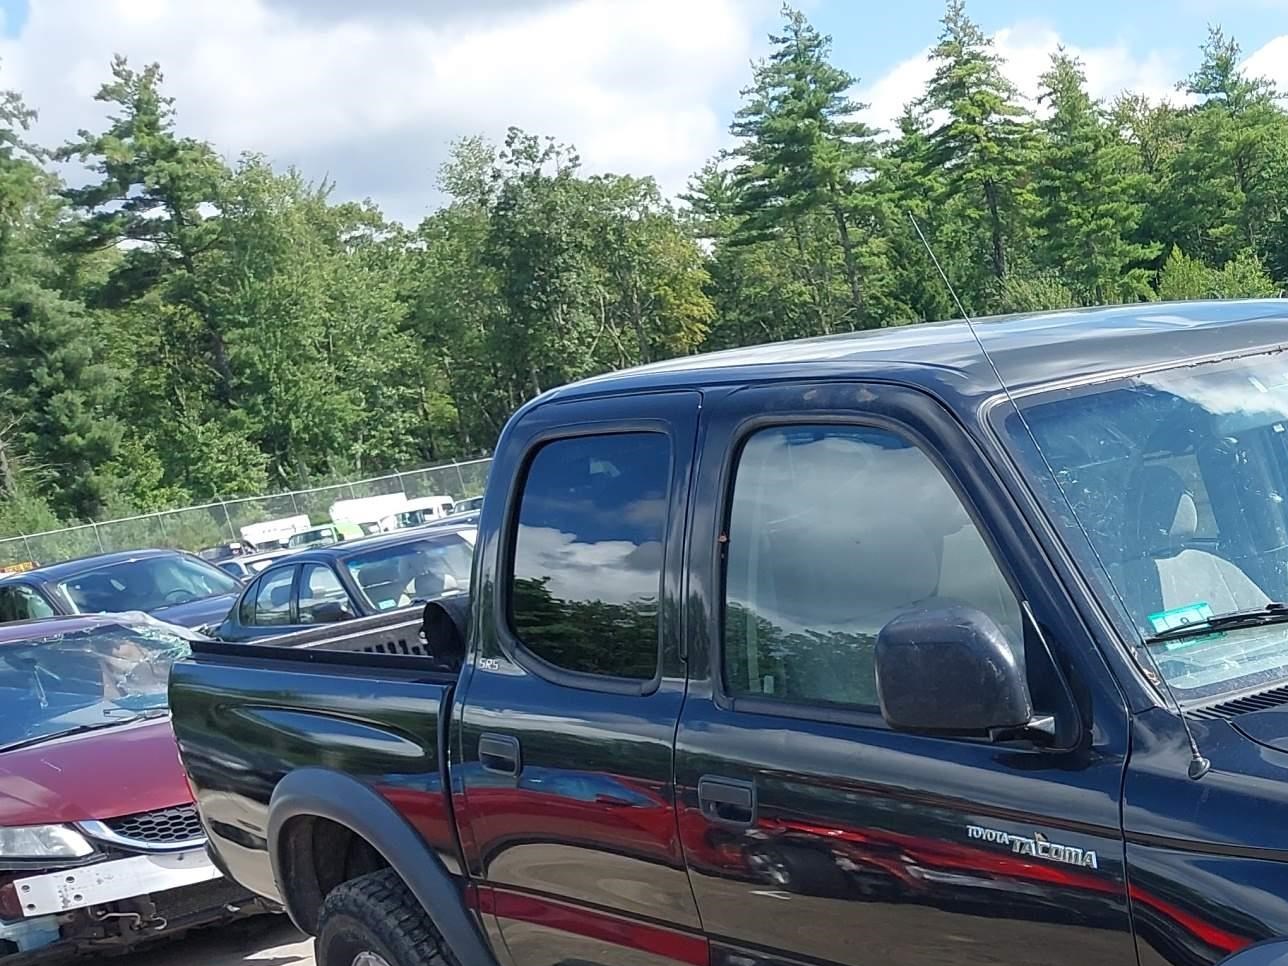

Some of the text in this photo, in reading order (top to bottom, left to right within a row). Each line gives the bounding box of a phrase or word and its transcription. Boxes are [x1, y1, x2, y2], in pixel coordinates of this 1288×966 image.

[479, 658, 499, 670] SRS
[966, 825, 1098, 869] TOYOTA TACOMA
